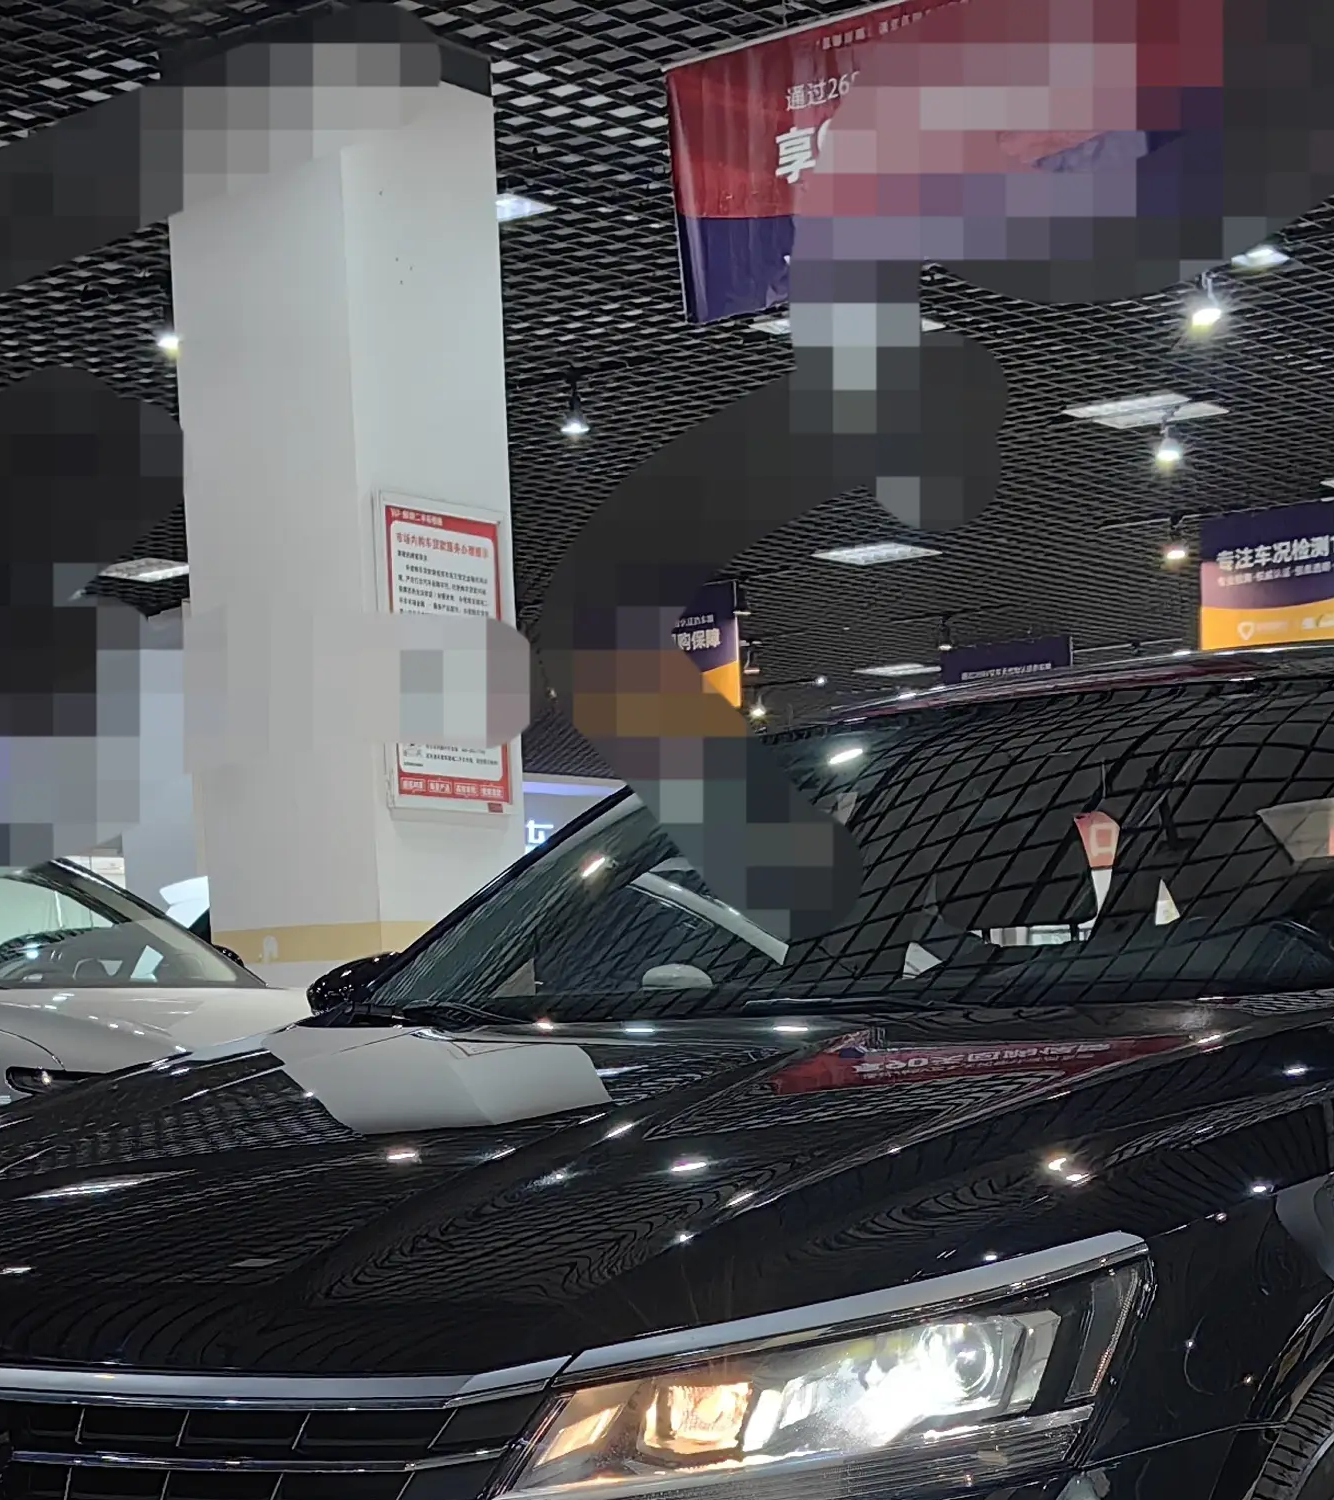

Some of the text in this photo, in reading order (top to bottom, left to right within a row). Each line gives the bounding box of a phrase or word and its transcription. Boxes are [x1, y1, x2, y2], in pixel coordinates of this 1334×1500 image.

[785, 71, 860, 111] 通过26
[671, 628, 721, 651] 购保障
